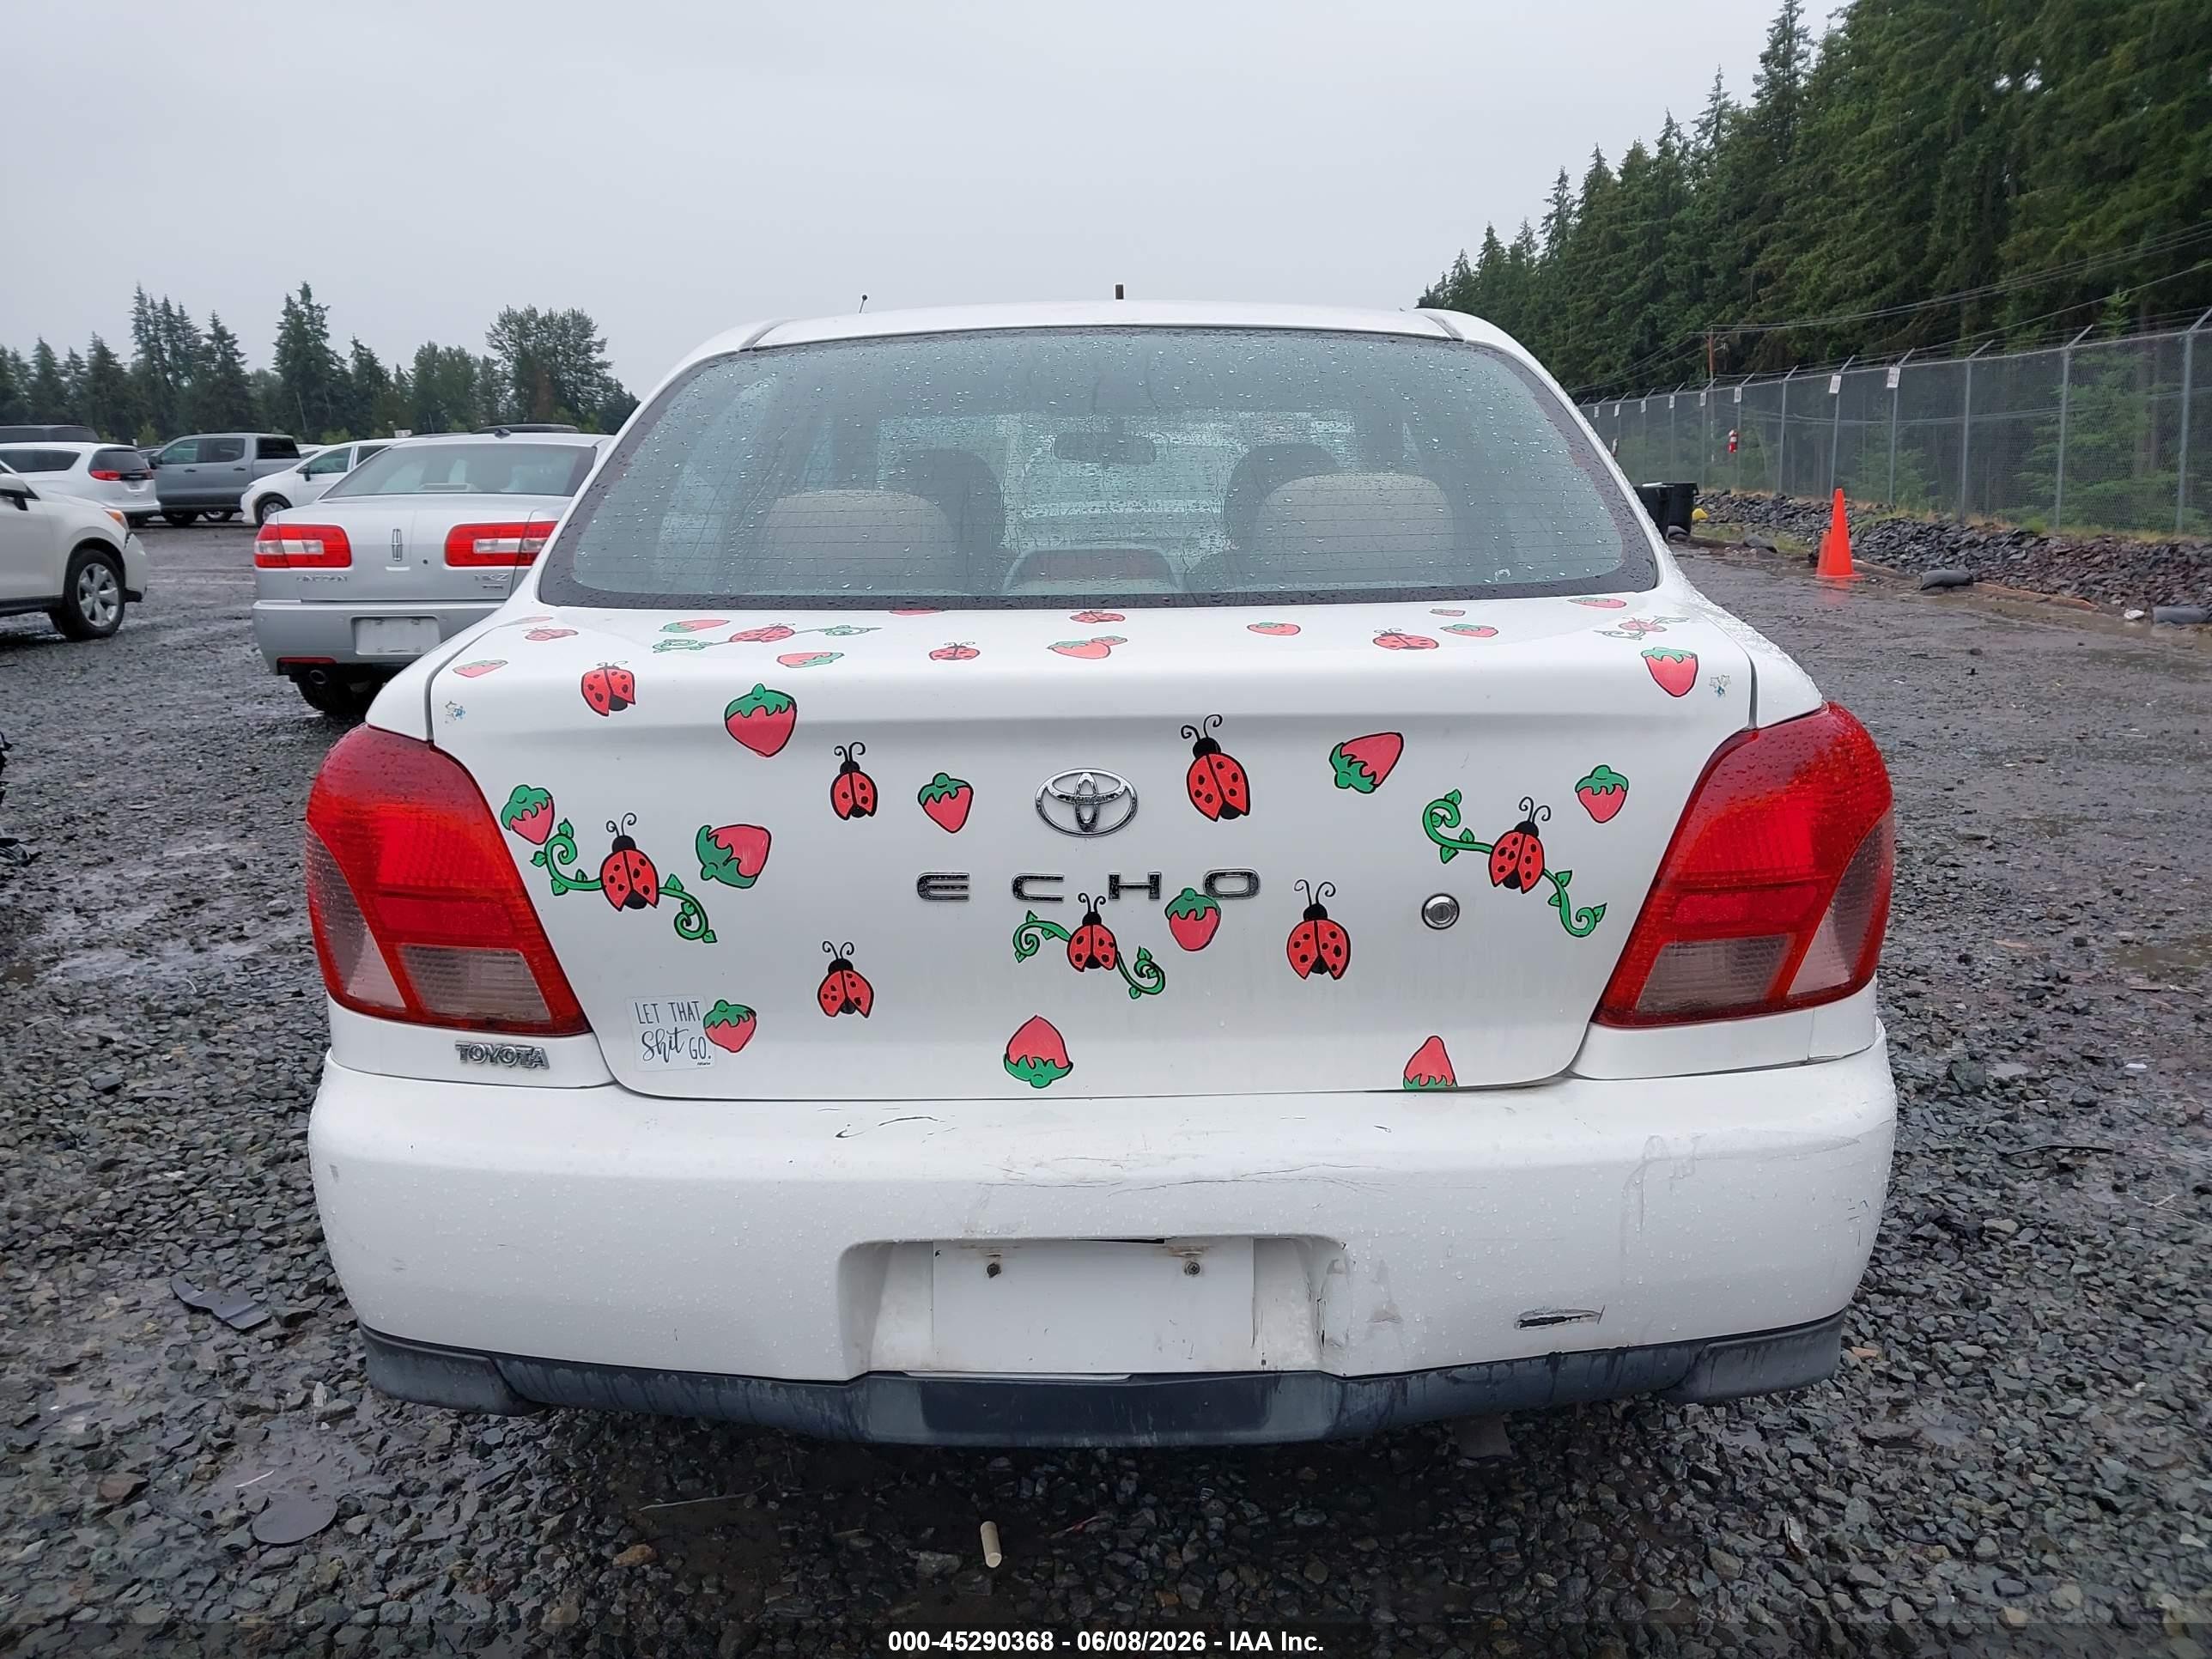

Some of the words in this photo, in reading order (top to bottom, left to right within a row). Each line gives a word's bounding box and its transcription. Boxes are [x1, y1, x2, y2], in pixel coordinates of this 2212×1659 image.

[916, 868, 1261, 902] ECHO
[635, 1001, 660, 1024] LET
[667, 1000, 701, 1022] THAT
[455, 1041, 550, 1069] TOYOTA
[641, 1026, 690, 1063] Shit
[689, 1036, 712, 1060] GO.
